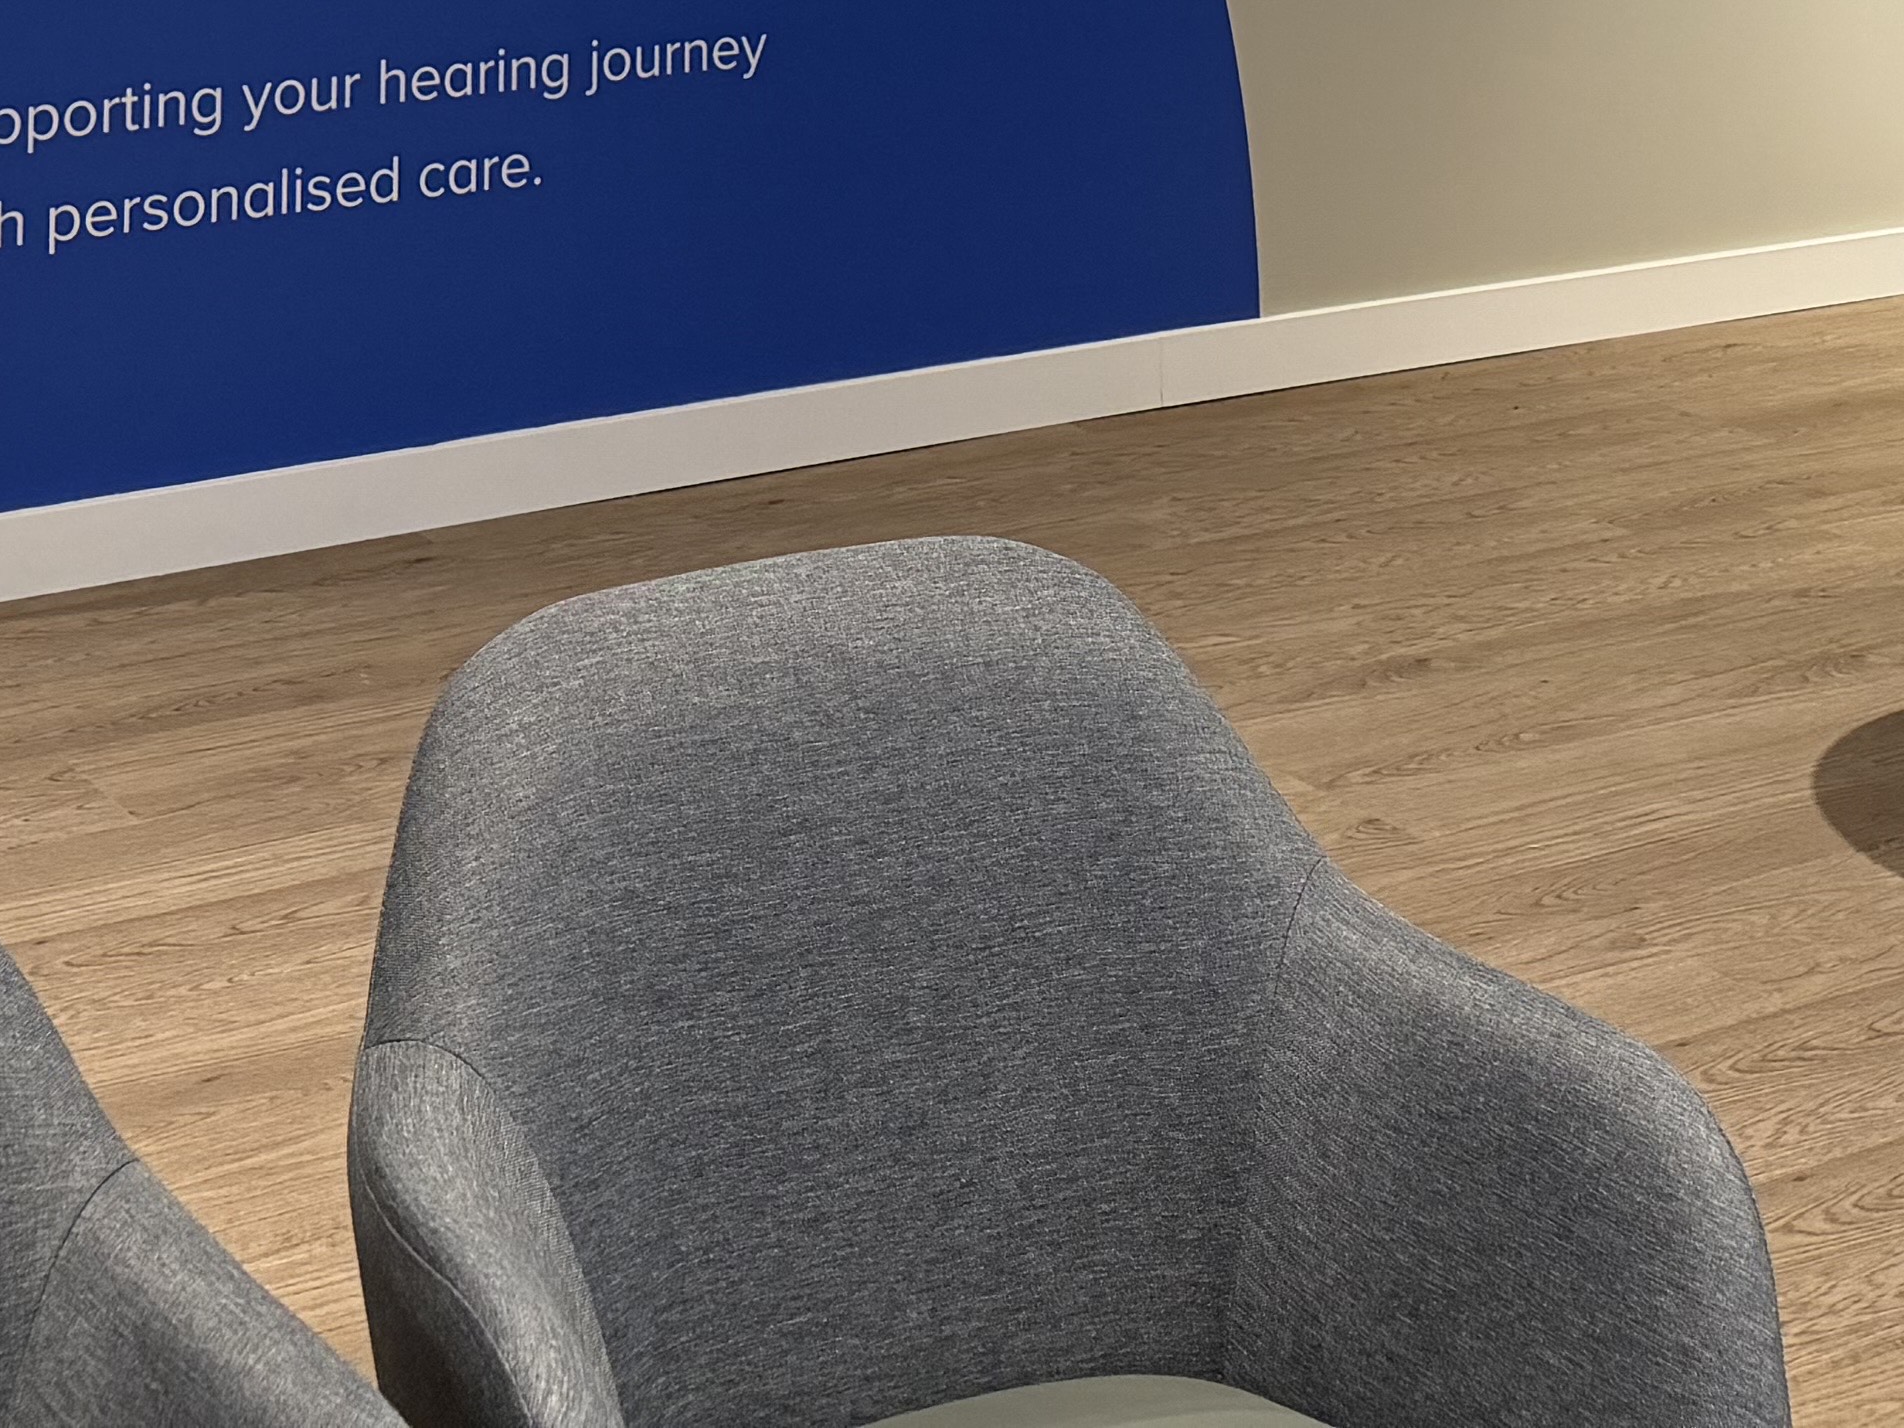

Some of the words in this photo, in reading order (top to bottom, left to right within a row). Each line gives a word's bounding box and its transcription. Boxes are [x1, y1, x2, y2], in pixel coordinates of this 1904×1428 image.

[241, 73, 362, 132] your
[378, 47, 571, 105] hearing
[585, 31, 768, 97] journey
[47, 155, 400, 255] personalised
[418, 153, 543, 198] care.
